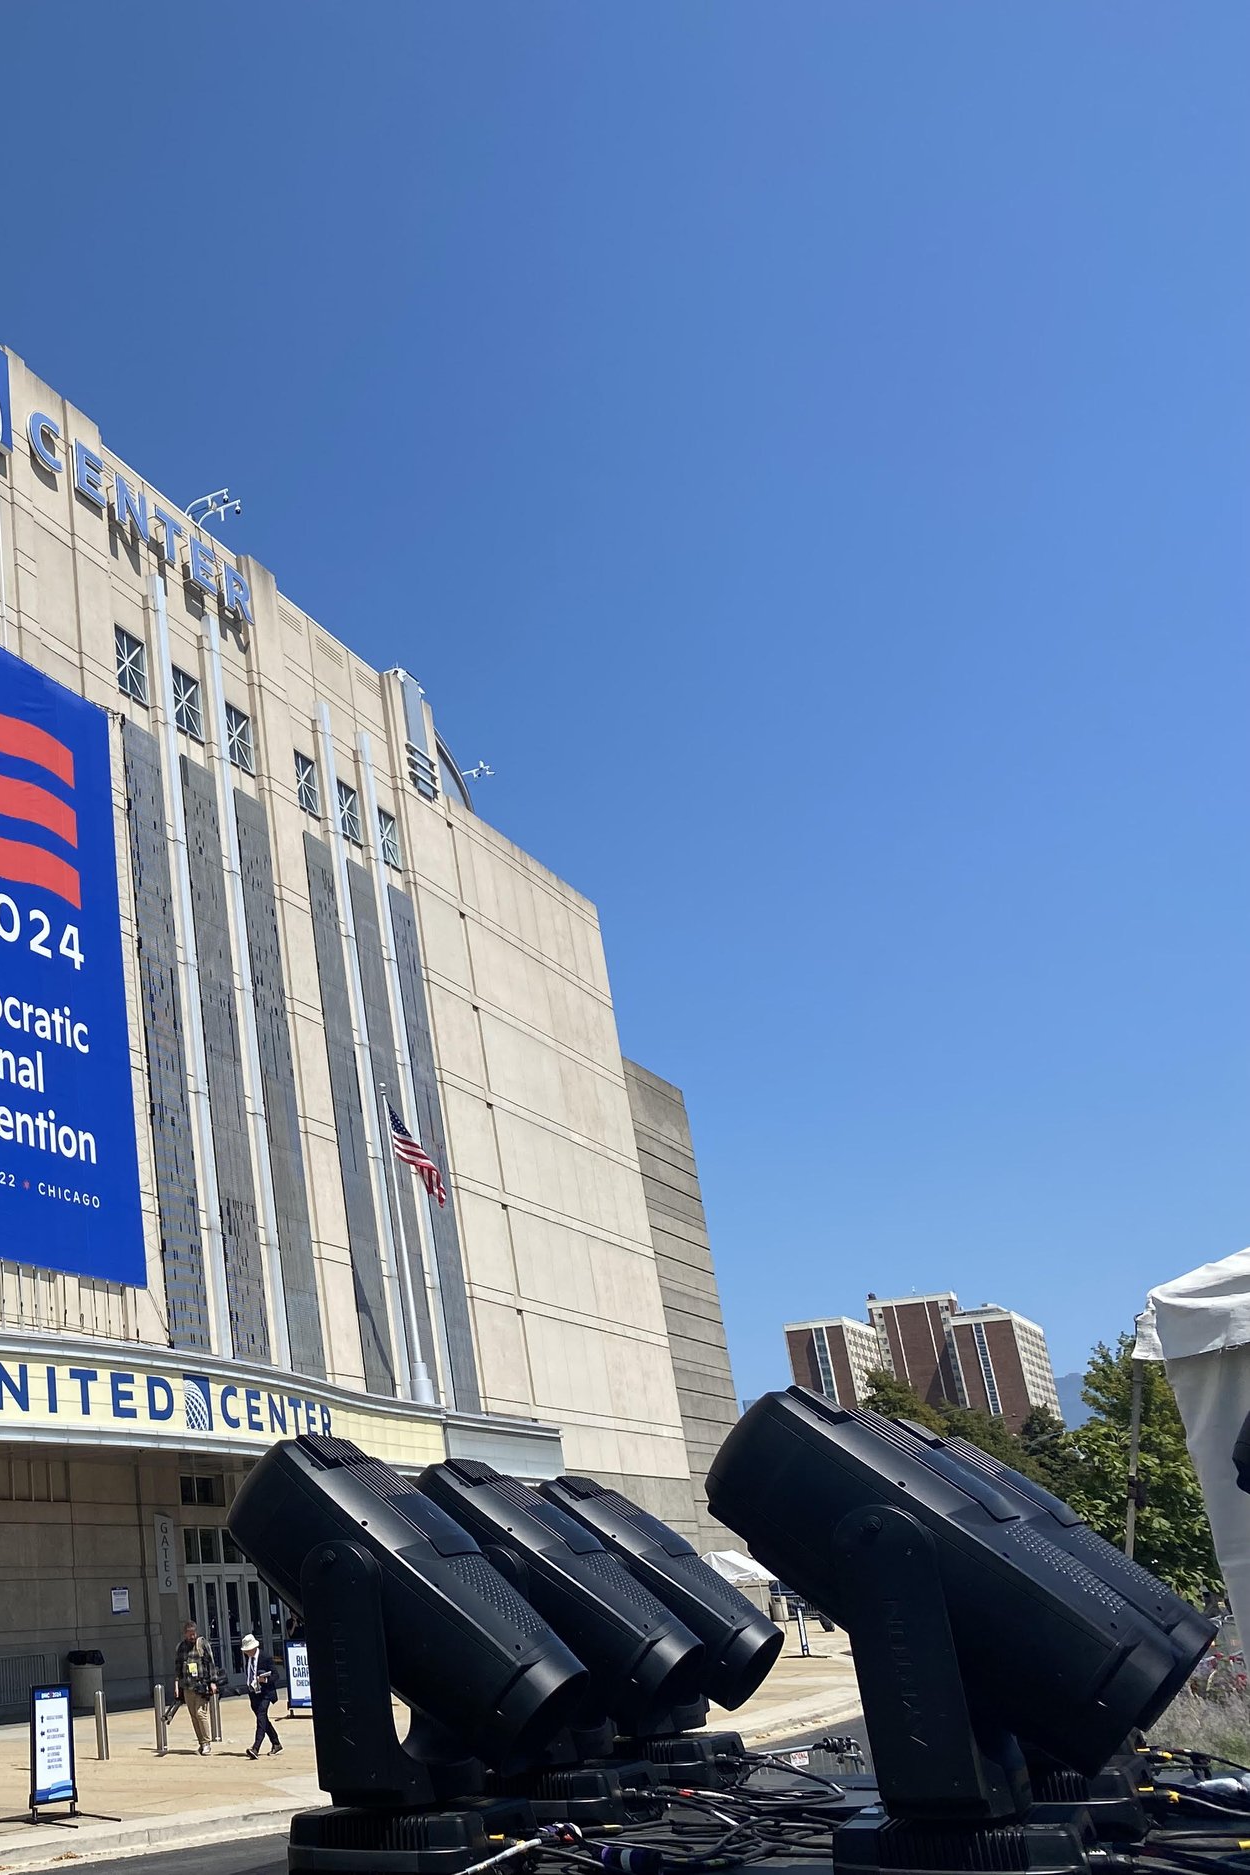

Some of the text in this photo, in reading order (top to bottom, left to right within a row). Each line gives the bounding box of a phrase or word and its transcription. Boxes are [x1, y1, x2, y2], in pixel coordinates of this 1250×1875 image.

[26, 410, 254, 625] CENTER
[37, 1182, 100, 1209] CHICAGO
[220, 1384, 332, 1438] CENTER
[160, 1522, 172, 1588] GATE 6
[296, 1655, 308, 1666] BLU
